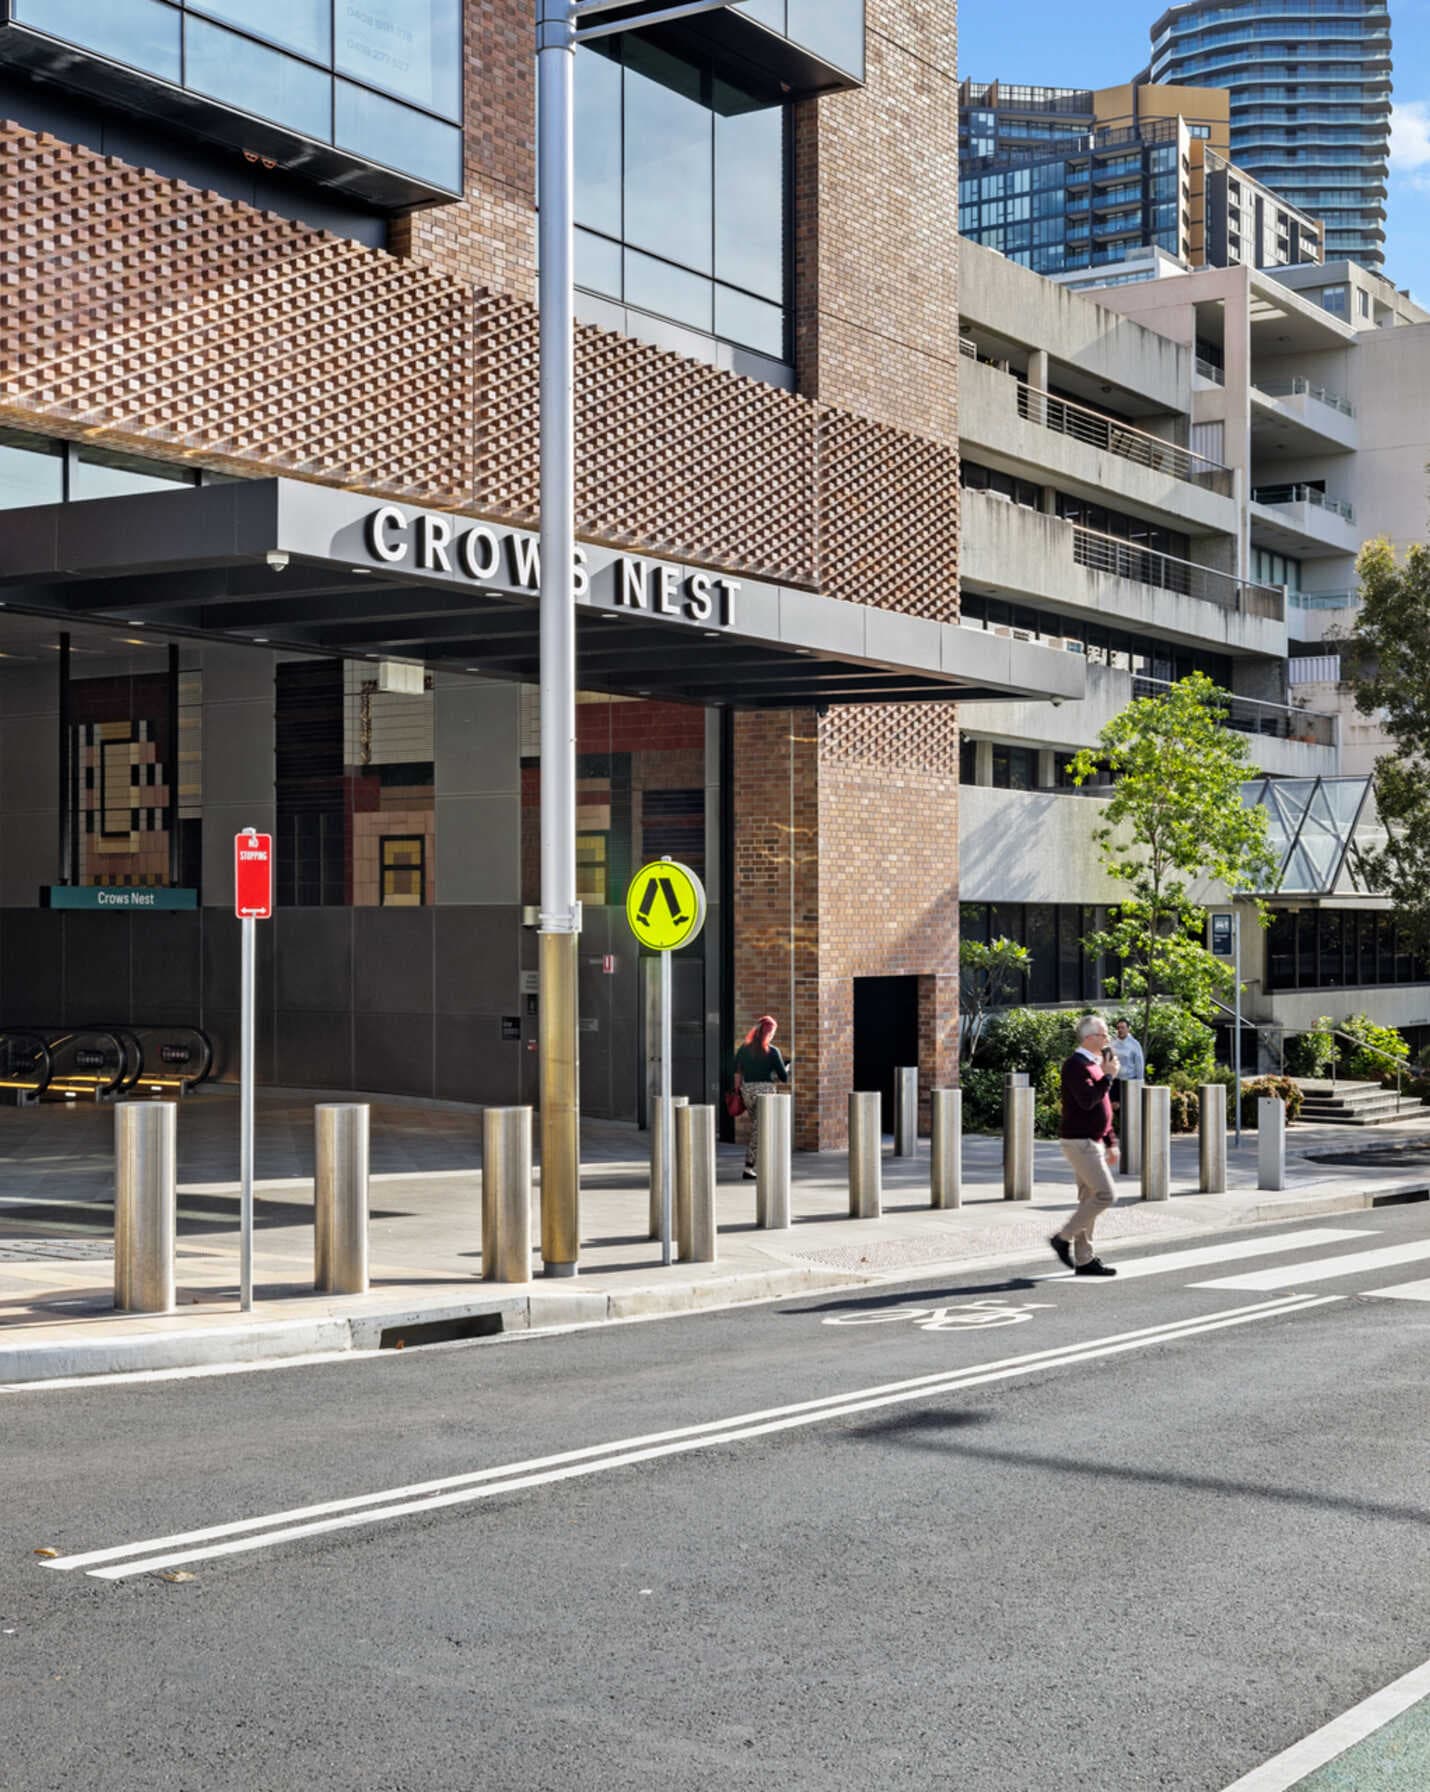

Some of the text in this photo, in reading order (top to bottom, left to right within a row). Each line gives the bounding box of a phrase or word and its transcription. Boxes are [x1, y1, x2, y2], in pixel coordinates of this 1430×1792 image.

[370, 506, 741, 627] CROWS NEST
[240, 850, 268, 861] STOPPING
[97, 891, 155, 905] Crows Nest
